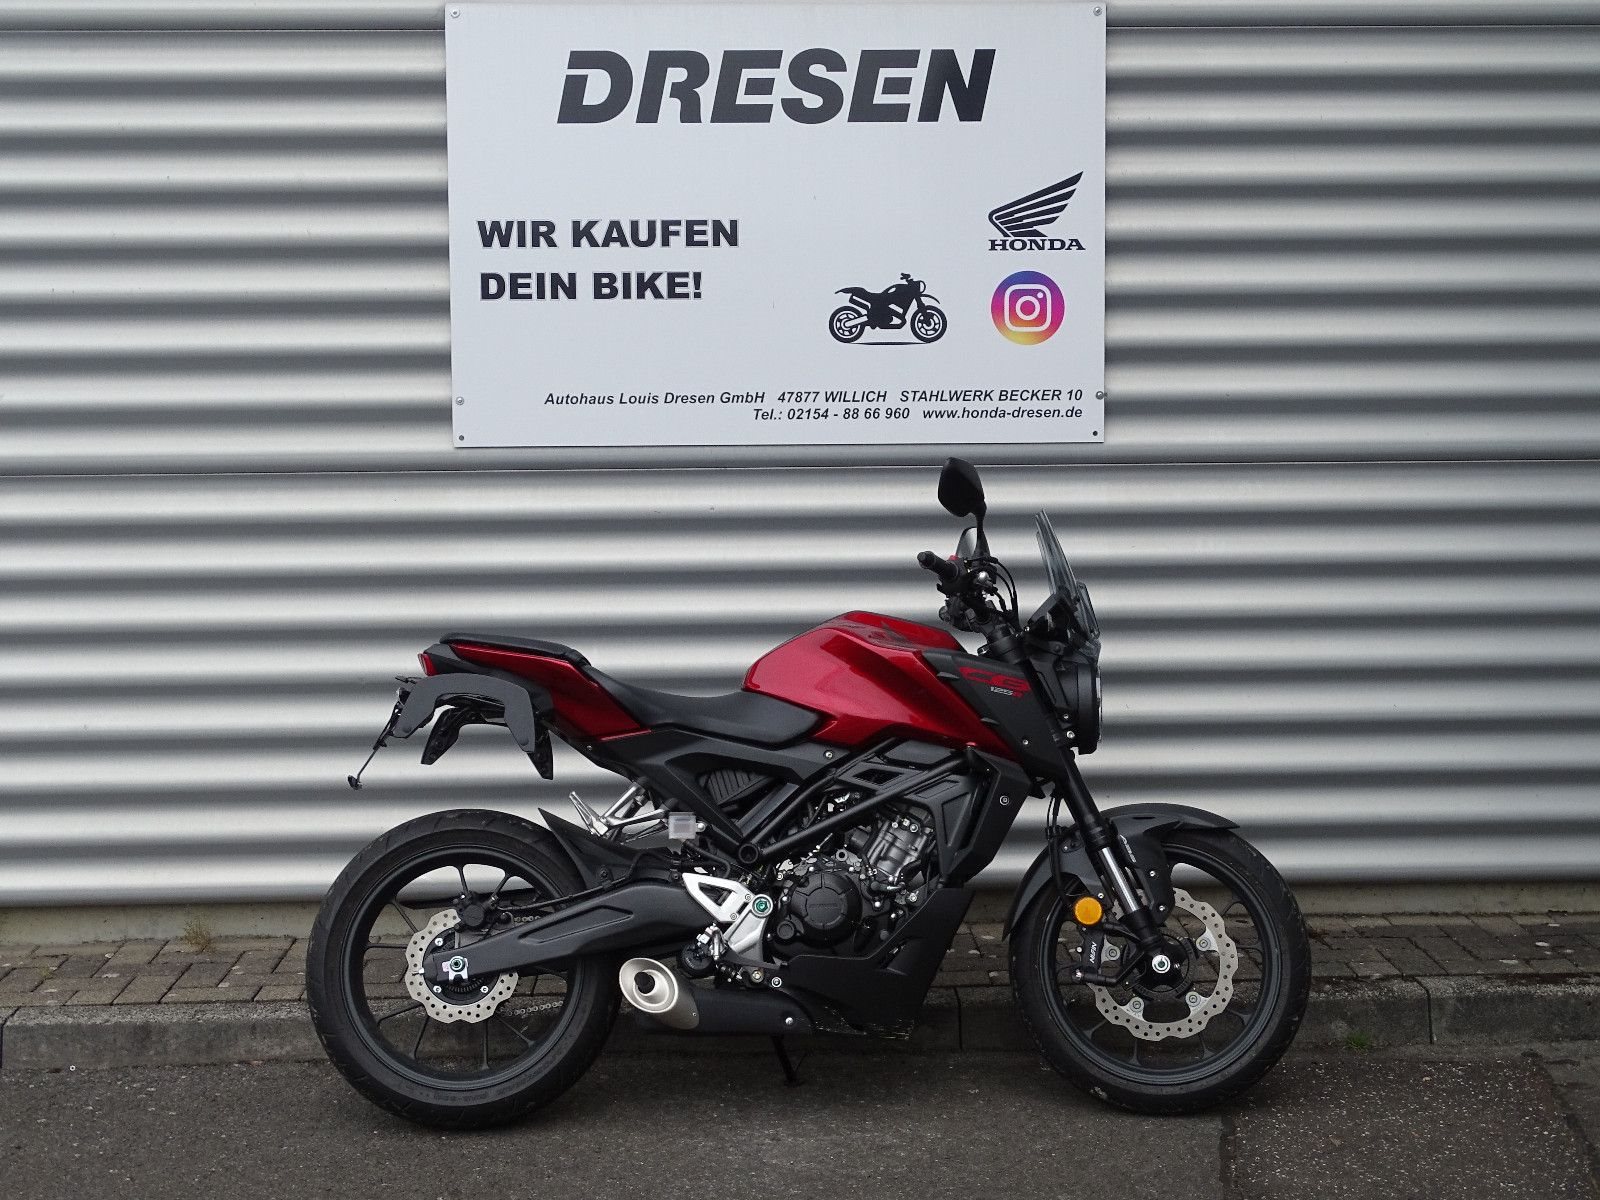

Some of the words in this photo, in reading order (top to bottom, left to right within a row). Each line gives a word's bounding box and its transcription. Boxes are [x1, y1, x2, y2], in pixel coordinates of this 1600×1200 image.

[557, 48, 996, 124] DRESEN
[477, 221, 557, 248] WIR
[572, 220, 739, 248] KAUFEN
[988, 238, 1086, 252] HONDA
[480, 273, 577, 301] DEIN
[593, 272, 703, 301] BIKE!
[544, 392, 614, 405] Autohaus
[619, 392, 660, 405] Louis
[664, 392, 715, 405] Dresen
[719, 391, 766, 404] GmbH
[777, 391, 821, 404] 47877
[824, 390, 888, 403] WILLICH
[900, 390, 995, 403] STAHLWERK
[998, 389, 1063, 402] BECKER
[1066, 389, 1083, 401] 10
[753, 408, 783, 421] Tel.:
[787, 408, 830, 420] 02154
[843, 408, 860, 420] 88
[864, 408, 881, 420] 66
[884, 407, 911, 419] 960
[922, 406, 1083, 419] www.honda-dresen.de
